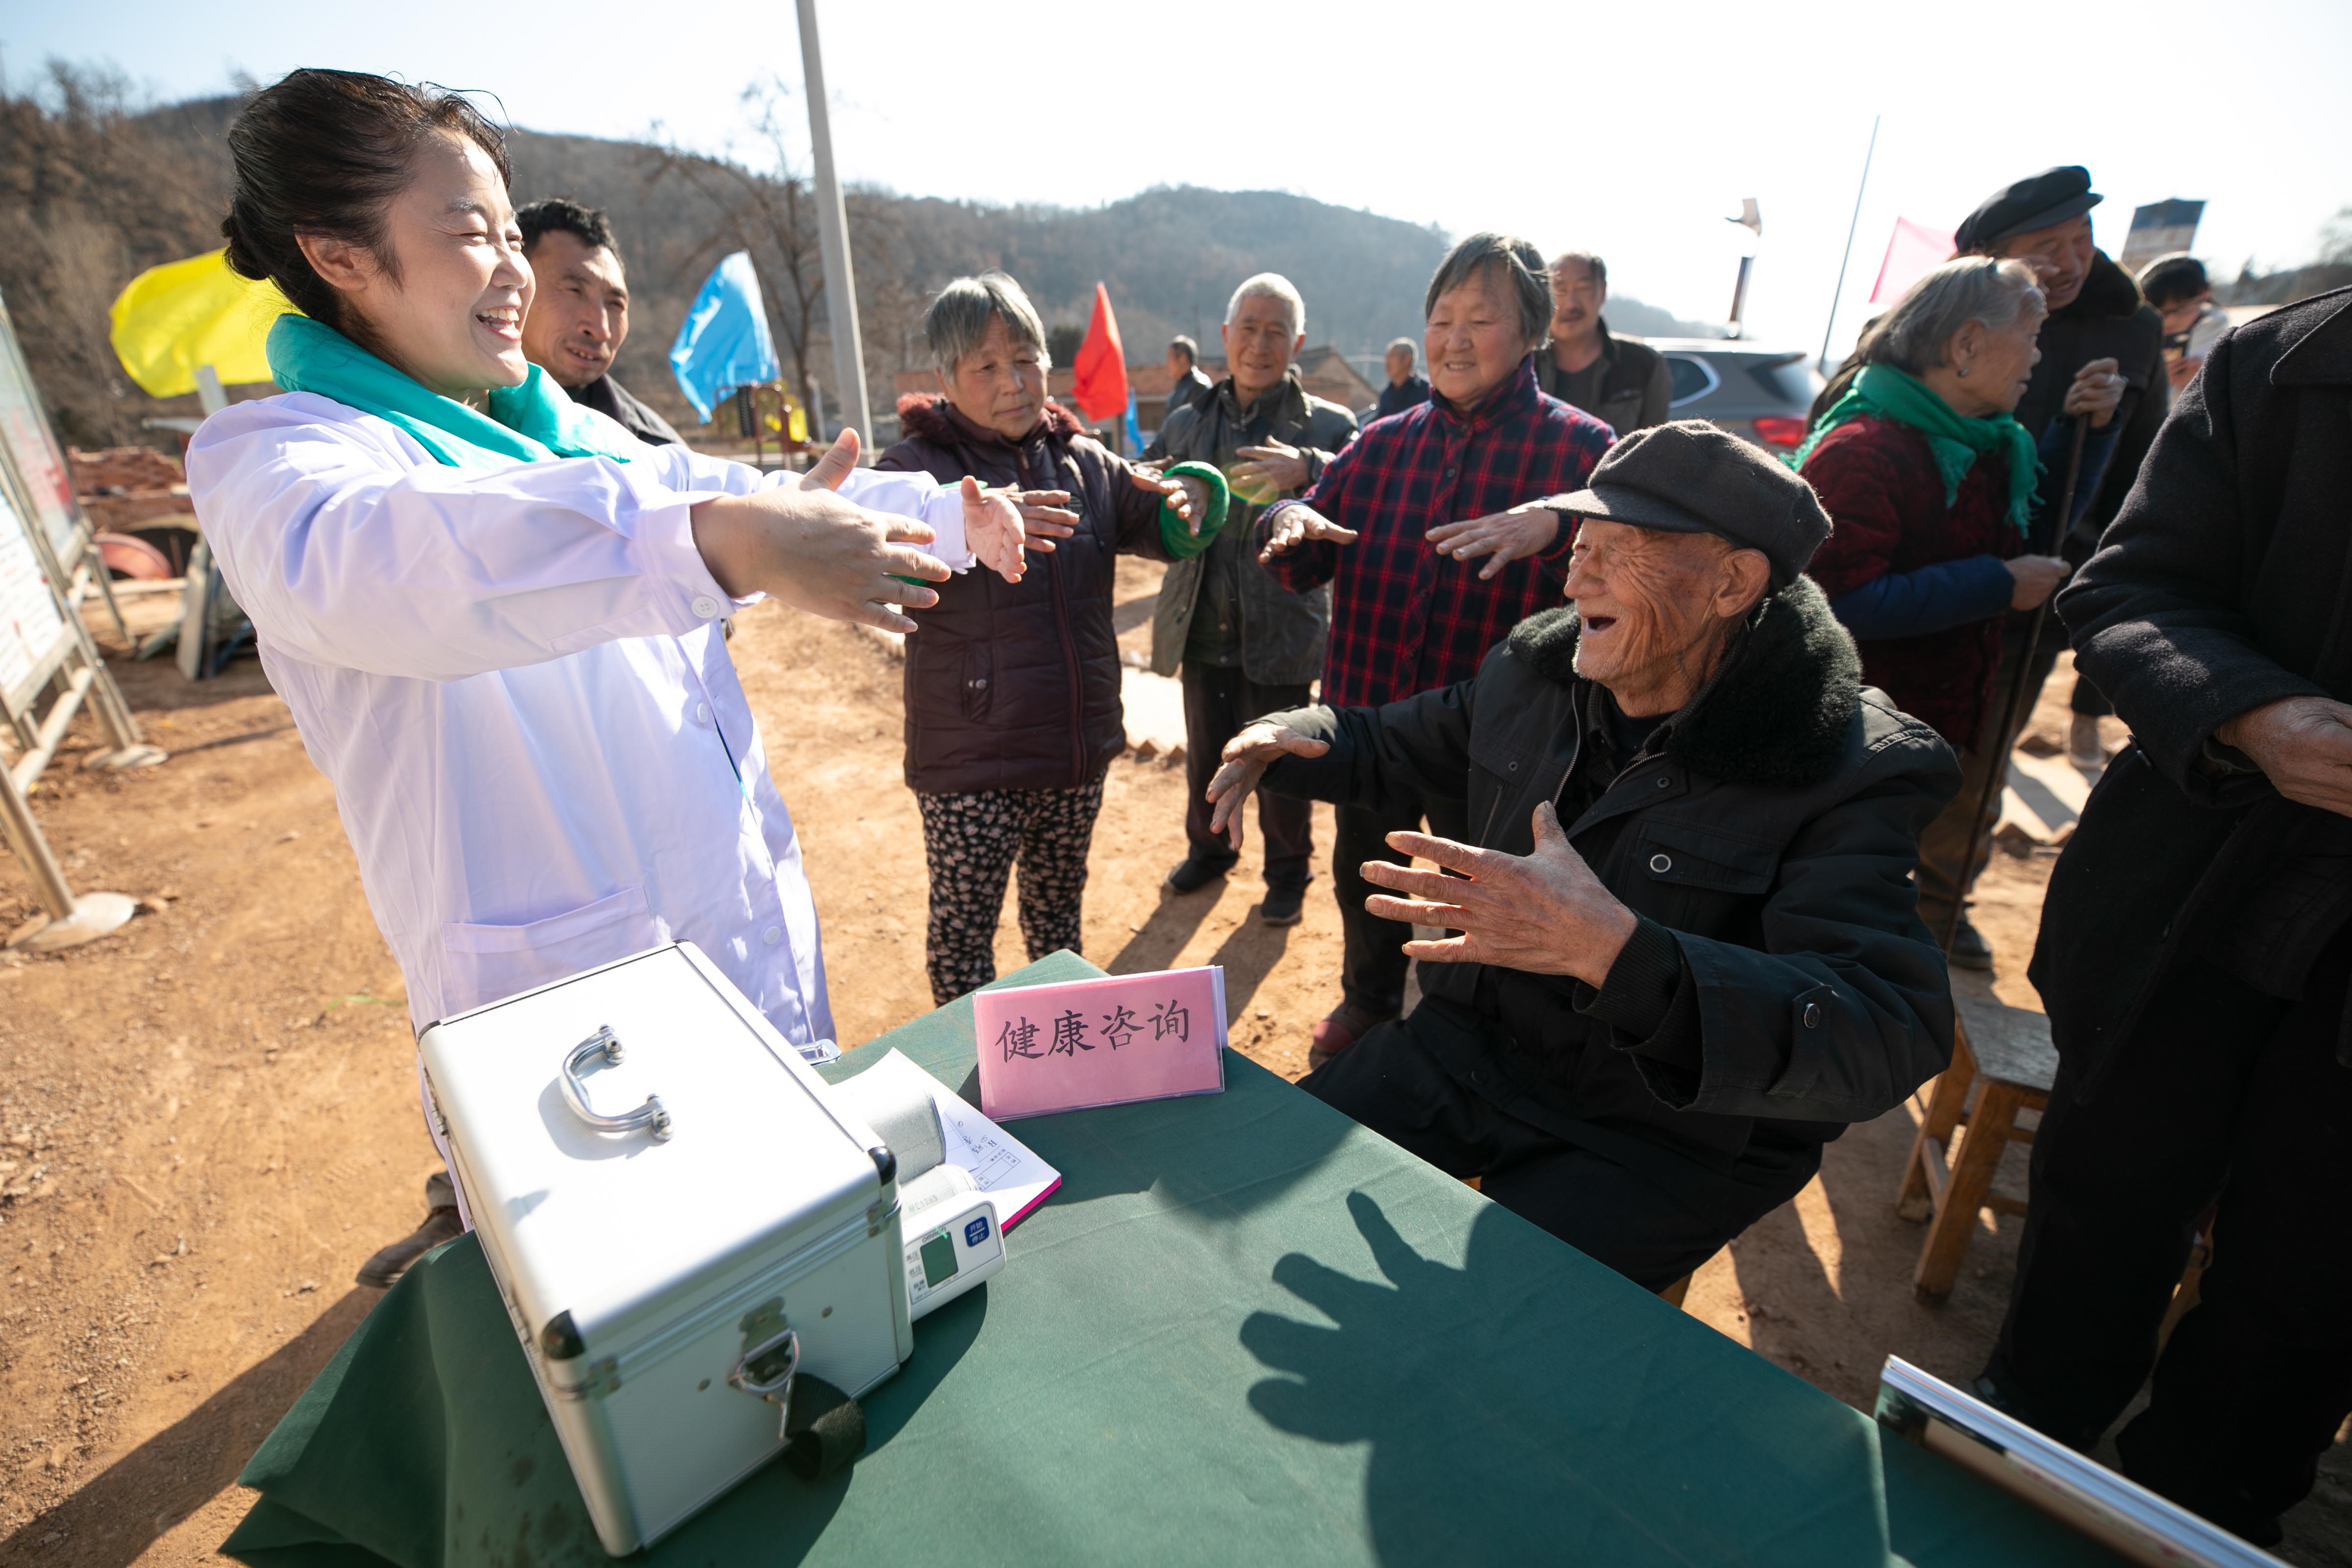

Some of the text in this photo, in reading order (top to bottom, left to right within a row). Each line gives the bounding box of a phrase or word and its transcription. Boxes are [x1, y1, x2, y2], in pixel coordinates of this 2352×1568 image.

[995, 999, 1189, 1062] 健康咨询
[969, 1222, 983, 1233] 开始
[972, 1232, 985, 1244] 停止
